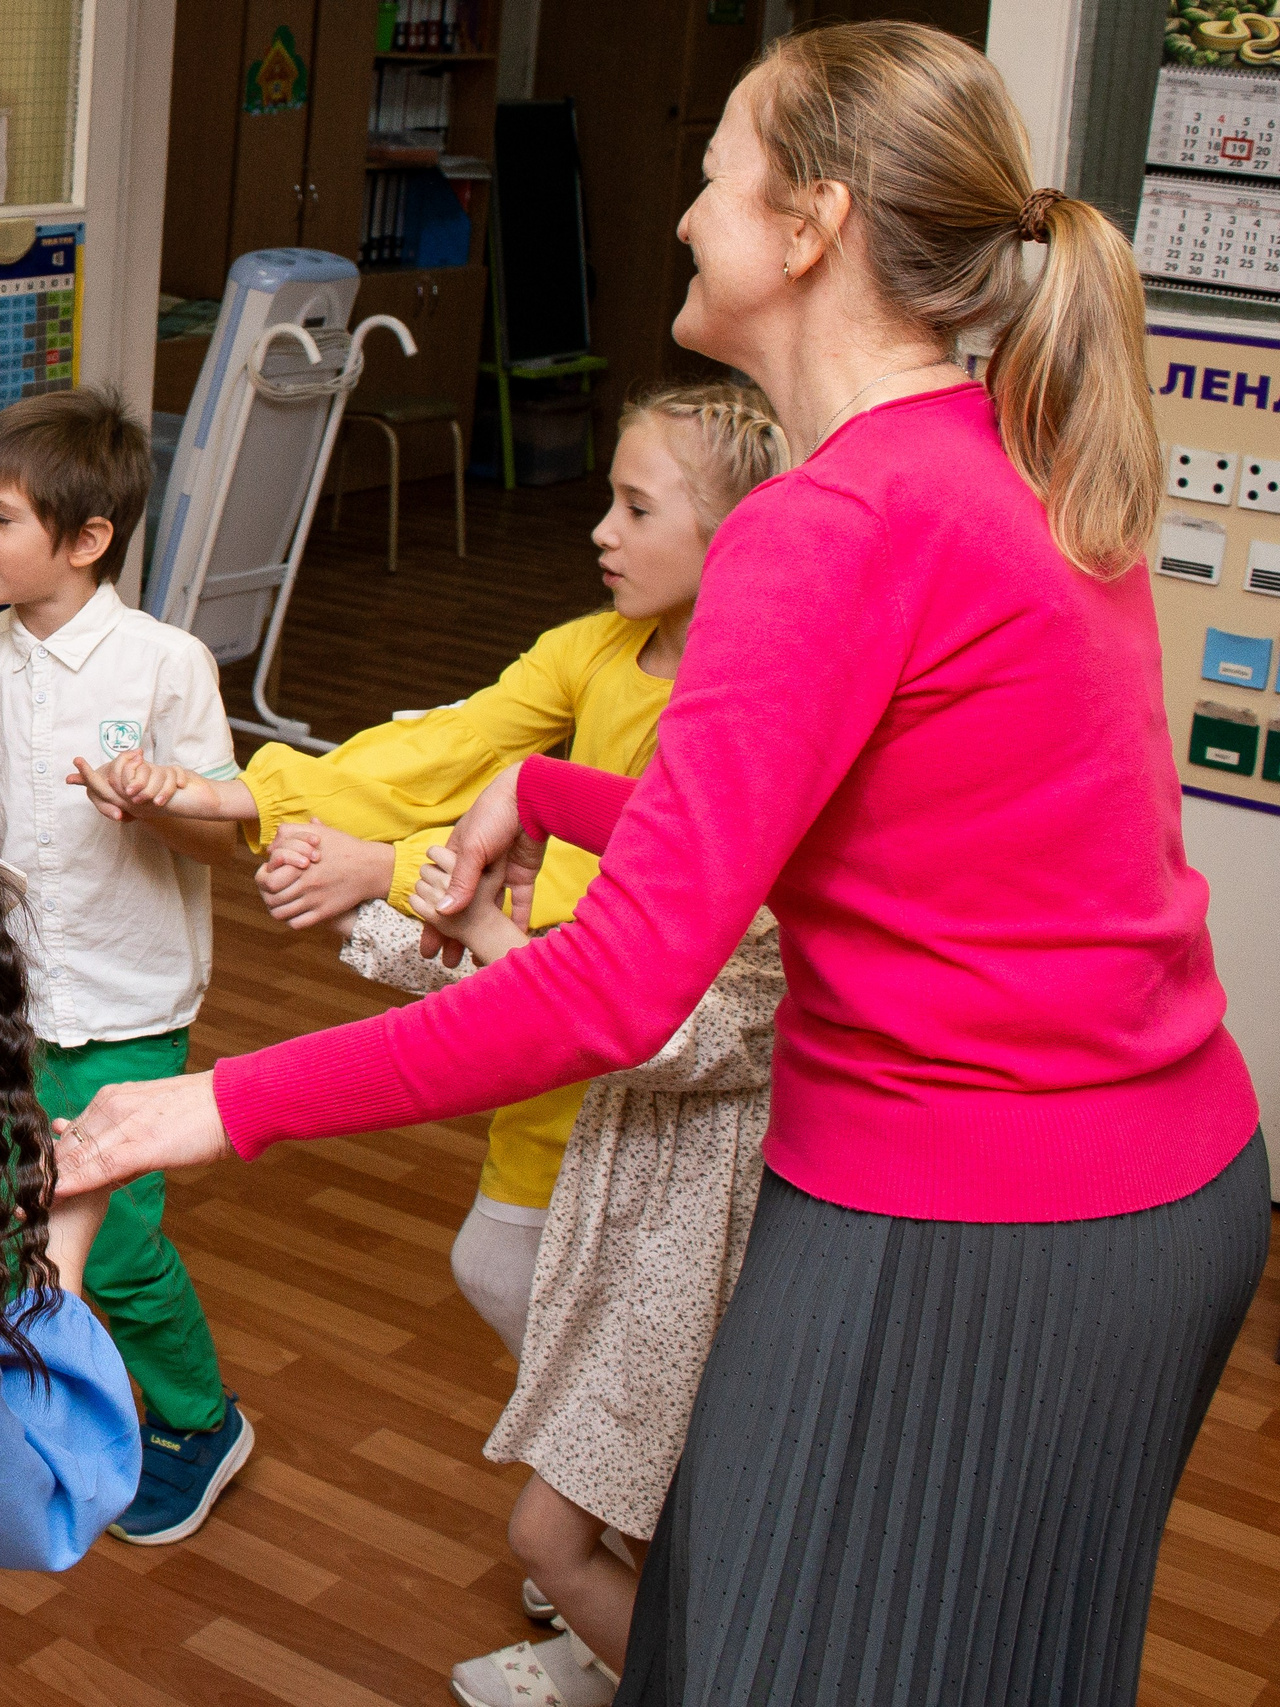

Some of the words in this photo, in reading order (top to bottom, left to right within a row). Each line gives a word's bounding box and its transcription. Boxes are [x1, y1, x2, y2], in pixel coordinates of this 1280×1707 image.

[1194, 113, 1201, 121] 3
[1218, 115, 1225, 123] 4
[1243, 117, 1250, 126] 5
[1268, 120, 1275, 128] 6
[1186, 125, 1199, 134] 10
[1210, 128, 1222, 137] 11
[1235, 130, 1248, 138] 12
[1259, 133, 1273, 142] 13
[1184, 139, 1197, 148] 17
[1208, 141, 1221, 151] 18
[1233, 144, 1246, 153] 19
[1256, 146, 1271, 156] 20
[1181, 152, 1194, 161] 24
[1205, 155, 1219, 164] 25
[1254, 160, 1268, 169] 27
[1182, 210, 1186, 218] 1
[1205, 213, 1212, 221] 2
[1229, 216, 1236, 224] 3
[1254, 219, 1261, 227] 4
[1179, 223, 1185, 232] 8
[1202, 226, 1209, 235] 9
[1221, 228, 1234, 238] 10
[1246, 231, 1257, 241] 11
[1170, 236, 1183, 245] 15
[1194, 239, 1206, 248] 16
[1219, 242, 1232, 251] 17
[1243, 245, 1256, 255] 18
[1167, 249, 1181, 259] 22
[1190, 252, 1204, 262] 23
[1215, 256, 1229, 265] 24
[1240, 259, 1254, 268] 25
[1265, 262, 1279, 272] 26
[1165, 262, 1178, 271] 29
[1189, 265, 1202, 275] 30
[1212, 269, 1225, 279] 31
[1149, 362, 1280, 413] ЛЕН
